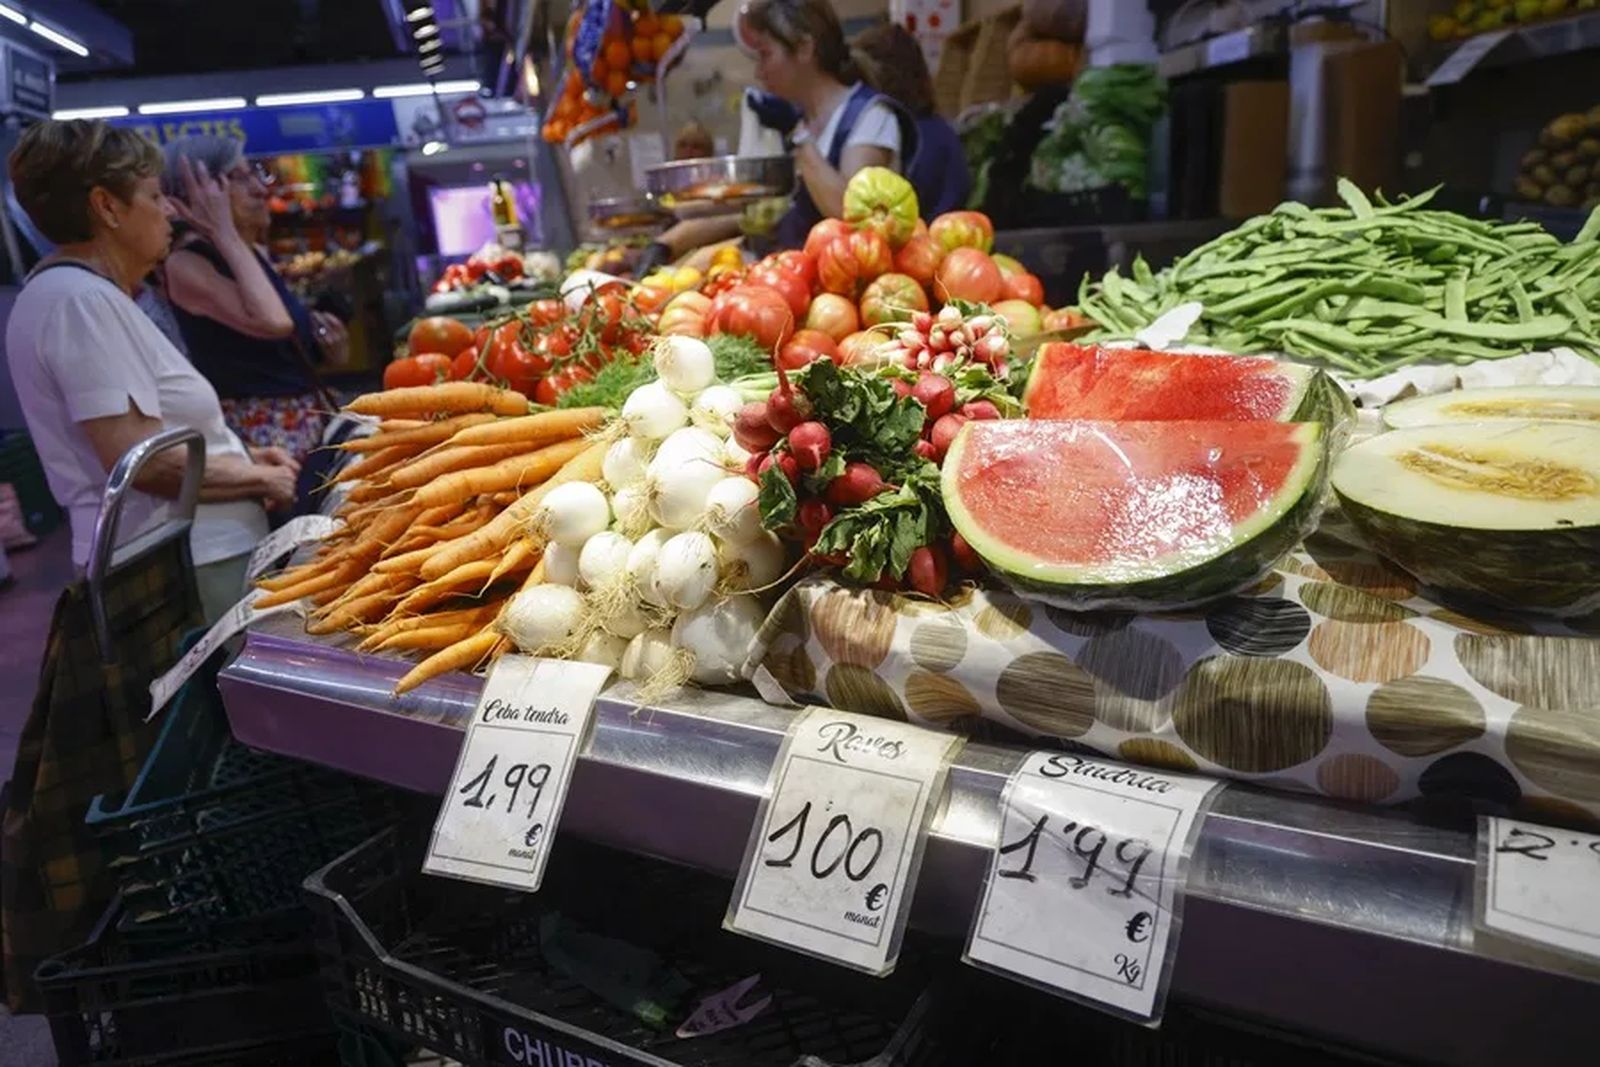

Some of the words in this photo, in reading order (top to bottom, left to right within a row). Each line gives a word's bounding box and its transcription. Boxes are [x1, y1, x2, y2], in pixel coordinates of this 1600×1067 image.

[482, 698, 520, 723] Ceba
[523, 704, 571, 725] tendra
[524, 823, 543, 847] €
[865, 883, 889, 911] €
[843, 911, 880, 928] manat
[1125, 911, 1153, 943] €
[1114, 953, 1141, 984] Kg
